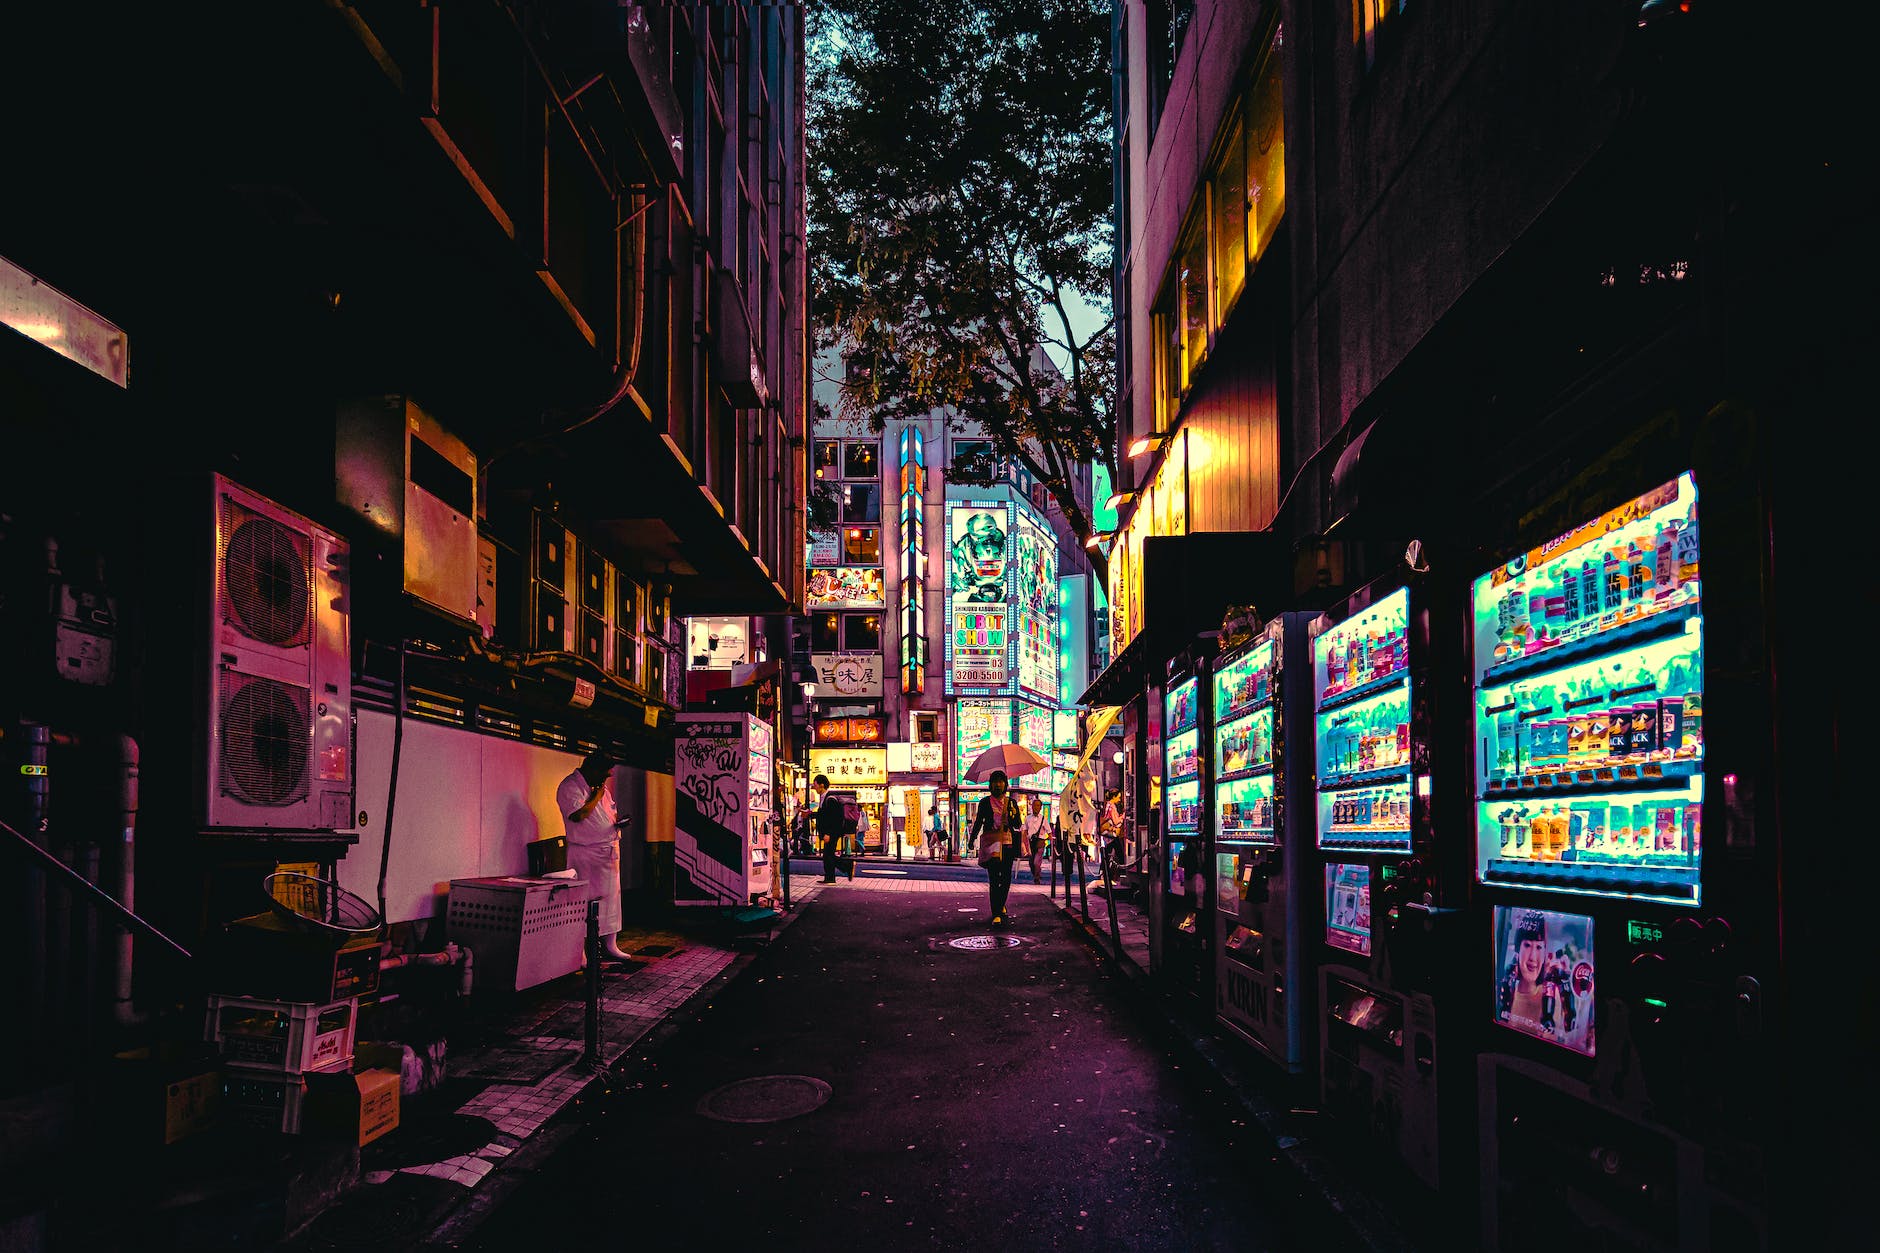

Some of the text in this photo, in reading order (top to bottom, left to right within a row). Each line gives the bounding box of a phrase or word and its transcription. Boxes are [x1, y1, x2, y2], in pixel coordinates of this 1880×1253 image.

[909, 484, 914, 495] 5
[909, 542, 915, 554] 4
[909, 599, 915, 611] 3
[956, 614, 1003, 630] ROBOT
[956, 629, 1003, 646] SHOW
[909, 657, 916, 670] 2
[992, 659, 1003, 668] 03
[821, 667, 877, 685] 旨味屋
[1632, 926, 1663, 942] 販売中
[1227, 967, 1268, 1025] KIRIN
